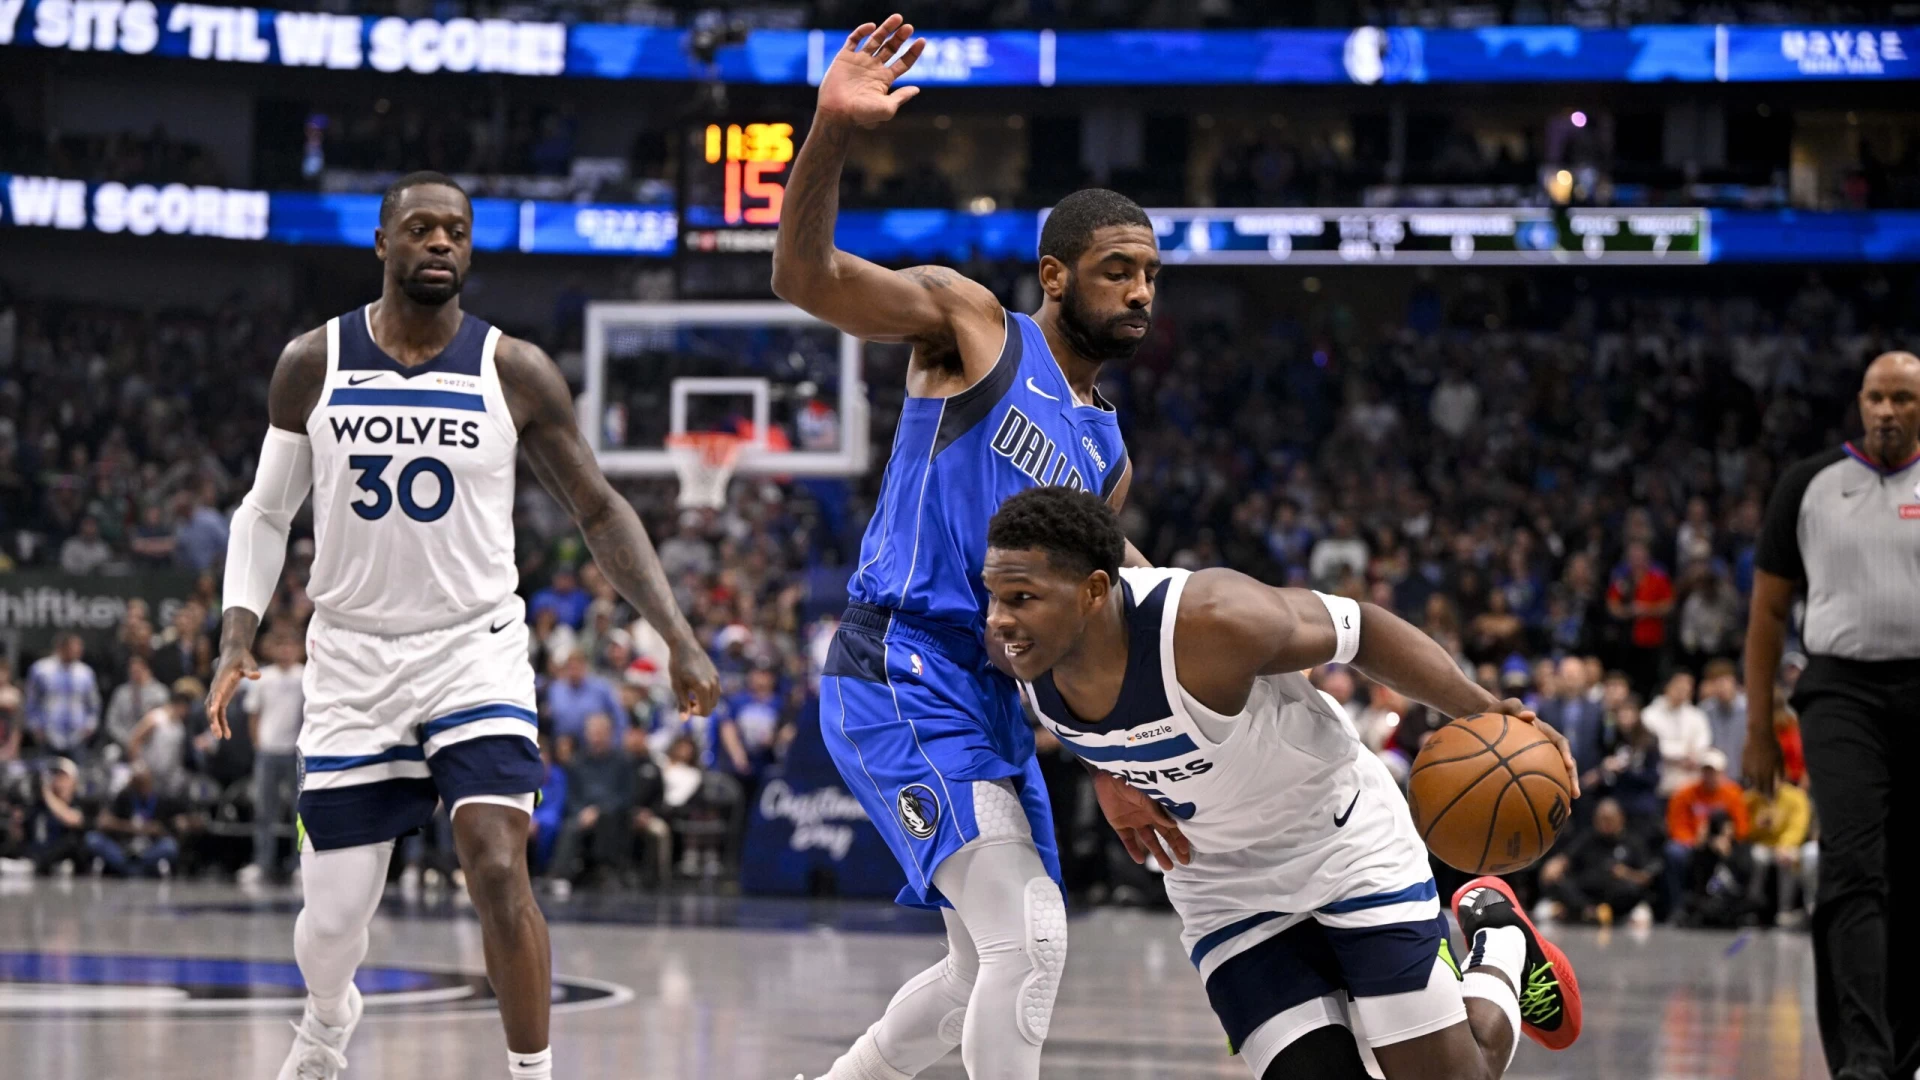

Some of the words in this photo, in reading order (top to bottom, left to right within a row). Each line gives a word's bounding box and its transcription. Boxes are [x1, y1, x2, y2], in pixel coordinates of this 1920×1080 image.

[33, 0, 158, 54] SITS
[274, 11, 363, 69] WE
[8, 175, 87, 230] WE
[724, 160, 786, 224] 15
[330, 416, 479, 449] WOLVES
[990, 404, 1089, 495] DALL
[1081, 435, 1107, 473] chime
[348, 455, 455, 523] 30
[1135, 725, 1173, 740] sezzle
[1110, 758, 1214, 785] LVES
